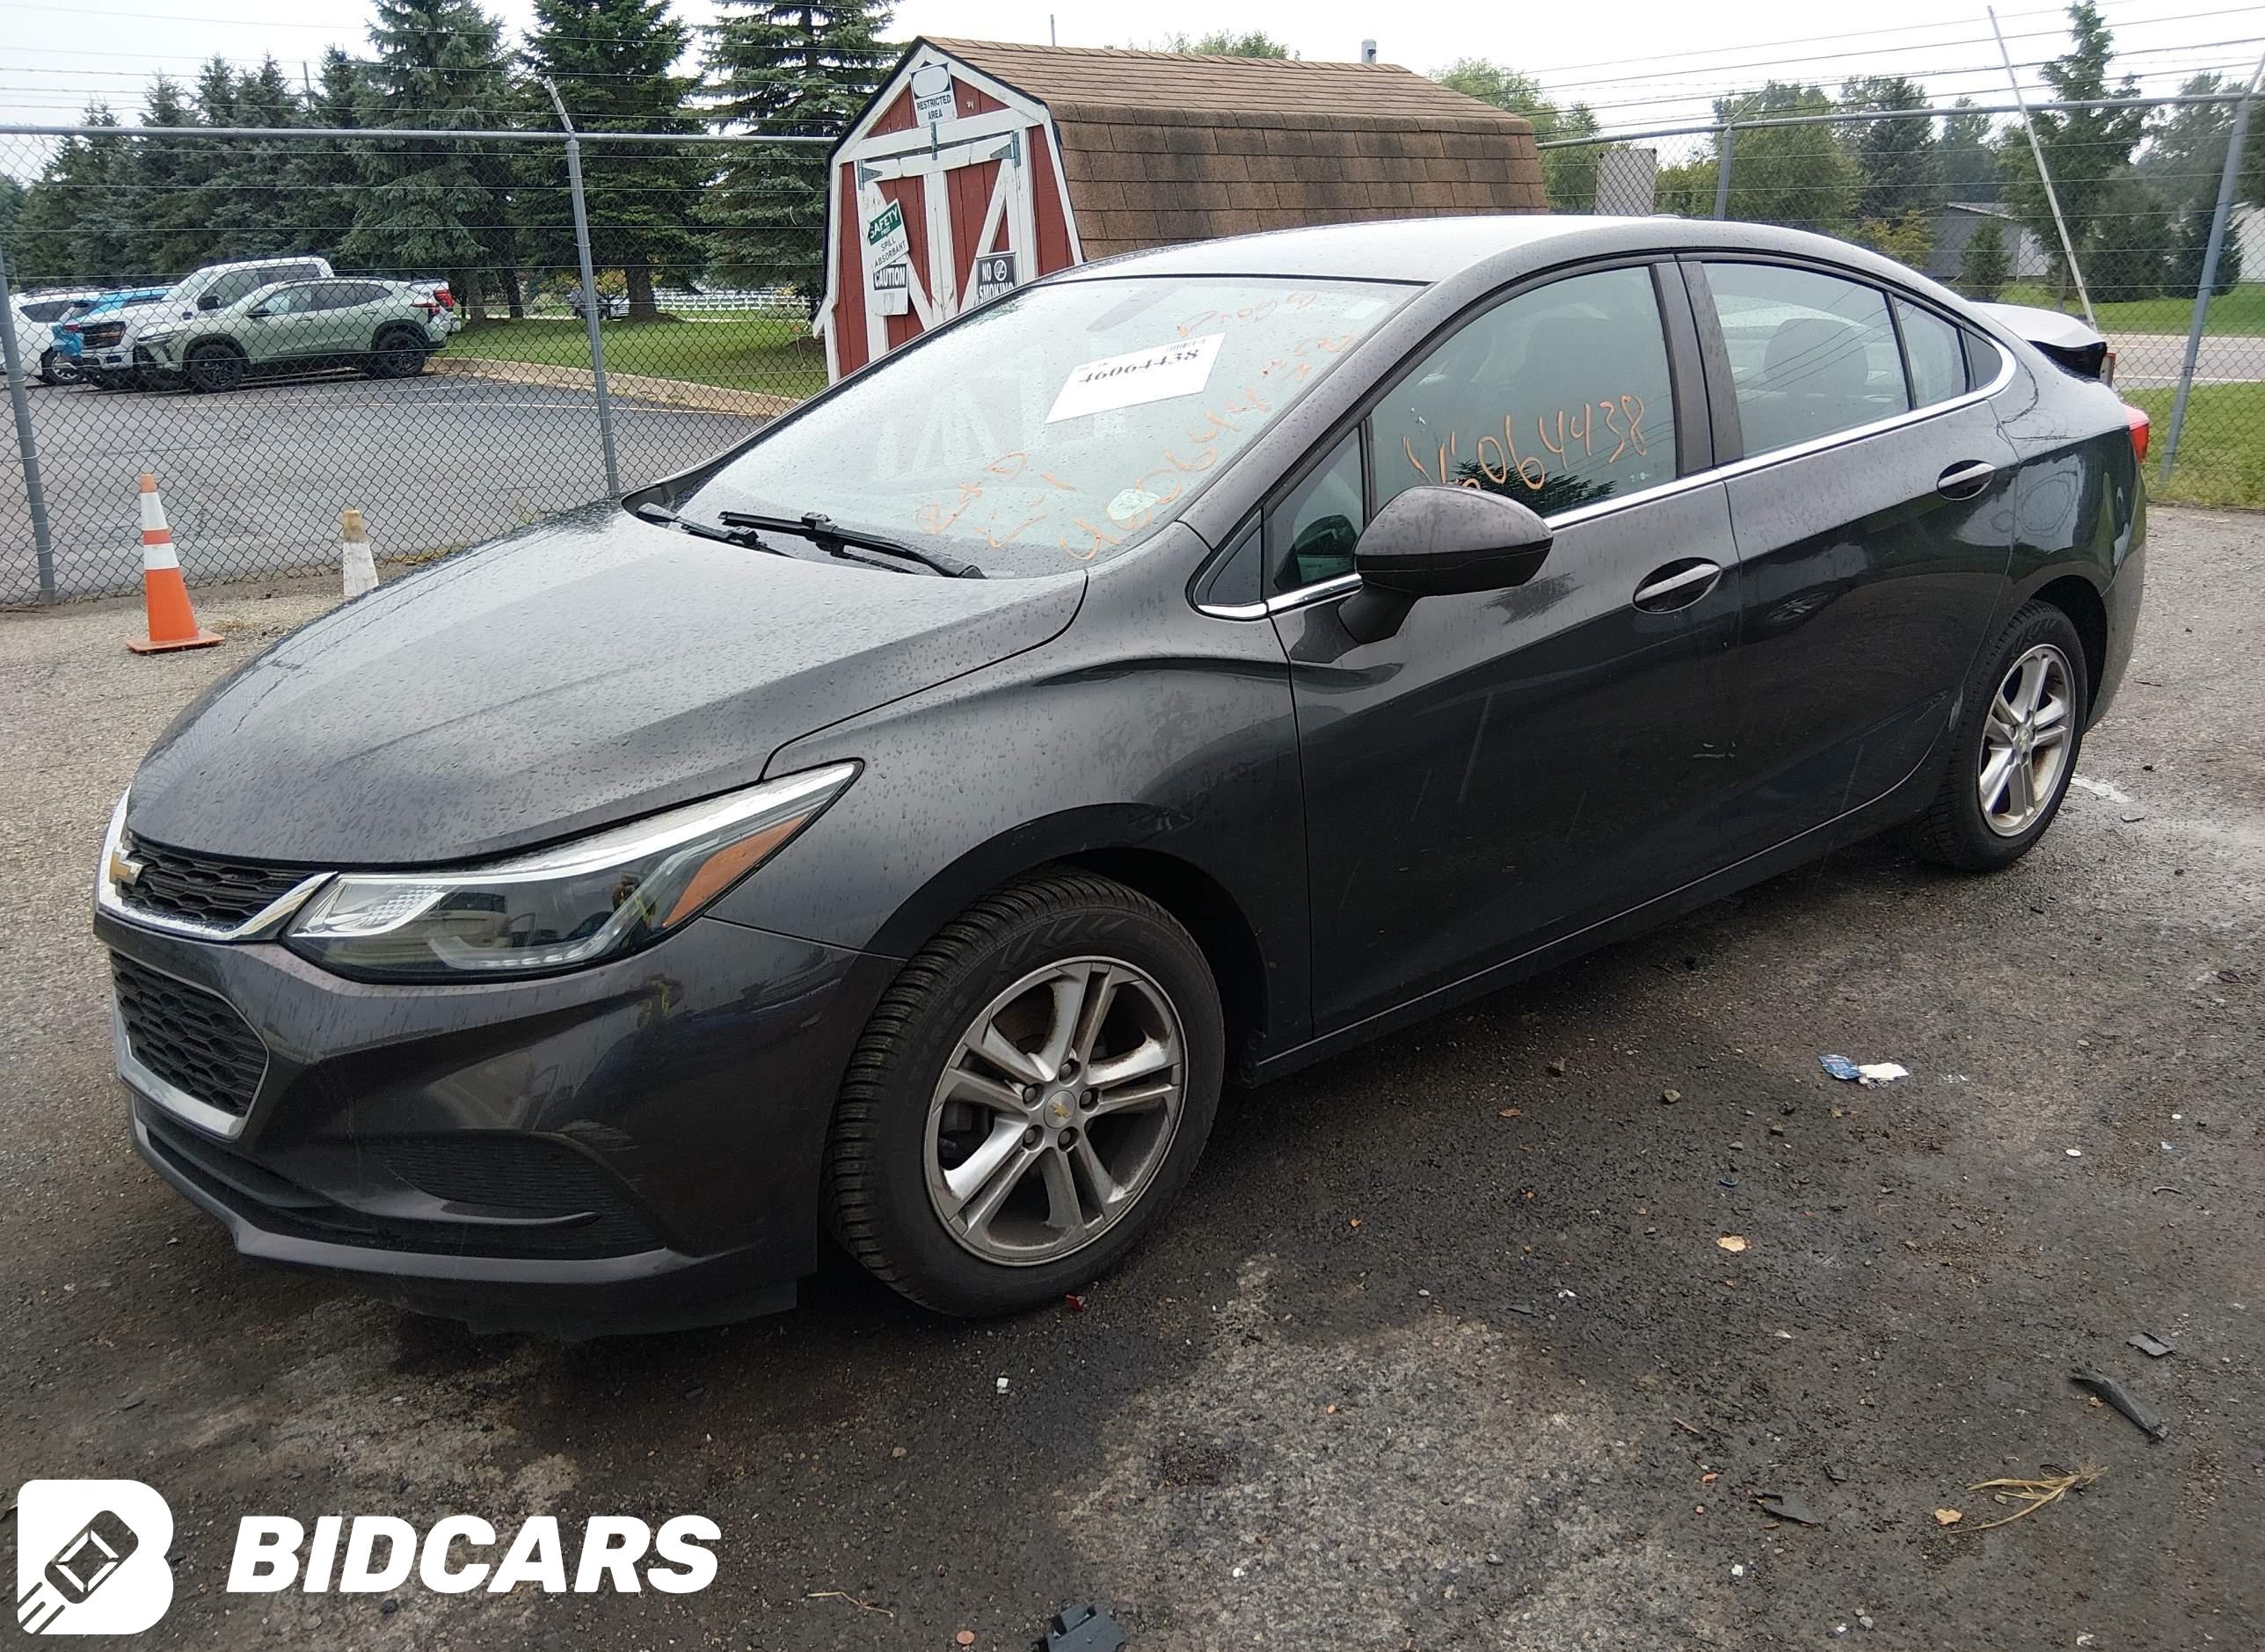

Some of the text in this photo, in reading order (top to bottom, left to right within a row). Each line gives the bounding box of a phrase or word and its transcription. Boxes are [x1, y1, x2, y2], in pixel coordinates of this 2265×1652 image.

[916, 94, 951, 112] RESTRICTED
[928, 108, 943, 120] AREA
[870, 206, 899, 240] SAFETY
[880, 235, 896, 251] SPILL
[874, 239, 907, 269] ABSORBANT
[874, 266, 906, 288] CAUTION
[981, 261, 992, 282] NO
[1078, 348, 1200, 384] 46064438
